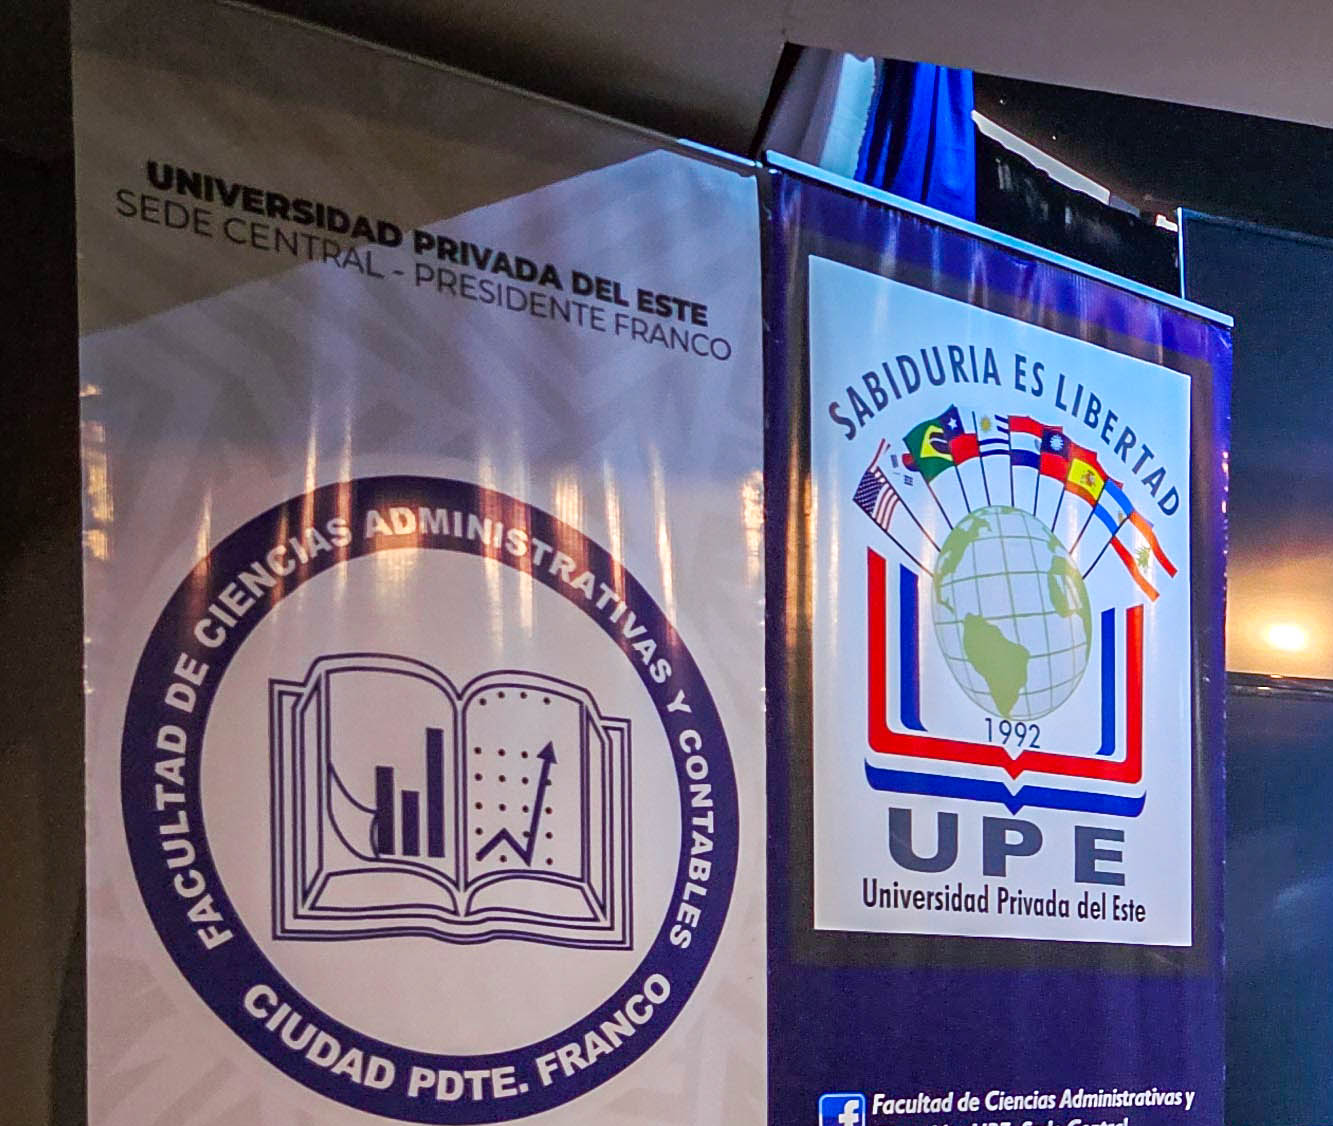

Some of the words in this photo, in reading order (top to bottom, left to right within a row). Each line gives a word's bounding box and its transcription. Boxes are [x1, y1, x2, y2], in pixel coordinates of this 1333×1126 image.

[115, 189, 213, 238] SEDE
[224, 219, 385, 280] CENTRAL
[415, 263, 606, 332] PRESIDENTE
[615, 315, 732, 362] FRANCO
[146, 160, 402, 248] UNIVERSIDAD
[414, 229, 562, 290] PRIVADA
[571, 270, 629, 308] DEL
[637, 290, 709, 327] ESTE
[827, 343, 1002, 441] SABIDURIA
[1013, 353, 1046, 398] ES
[1055, 372, 1182, 518] LIBERTAD
[194, 517, 352, 648] CIENCIAS
[364, 506, 673, 684] ADMINISTRATIVAS
[172, 652, 209, 714] DE
[665, 690, 690, 714] Y
[984, 717, 1041, 750] 1992
[154, 723, 233, 950] FACULTAD
[670, 729, 713, 949] CONTABLES
[862, 878, 990, 915] Universidad
[997, 886, 1072, 918] Privada
[1077, 891, 1106, 921] del
[1112, 894, 1147, 924] Este
[887, 807, 1126, 887] UPE
[243, 985, 396, 1090] CIUDAD
[407, 1065, 528, 1101] PDTE.
[536, 973, 671, 1086] FRANCO
[872, 1092, 953, 1115] Facultad
[957, 1091, 980, 1112] de
[984, 1090, 1057, 1111] Ciencias
[1059, 1088, 1182, 1109] Administrativas
[1181, 1090, 1195, 1110] y
